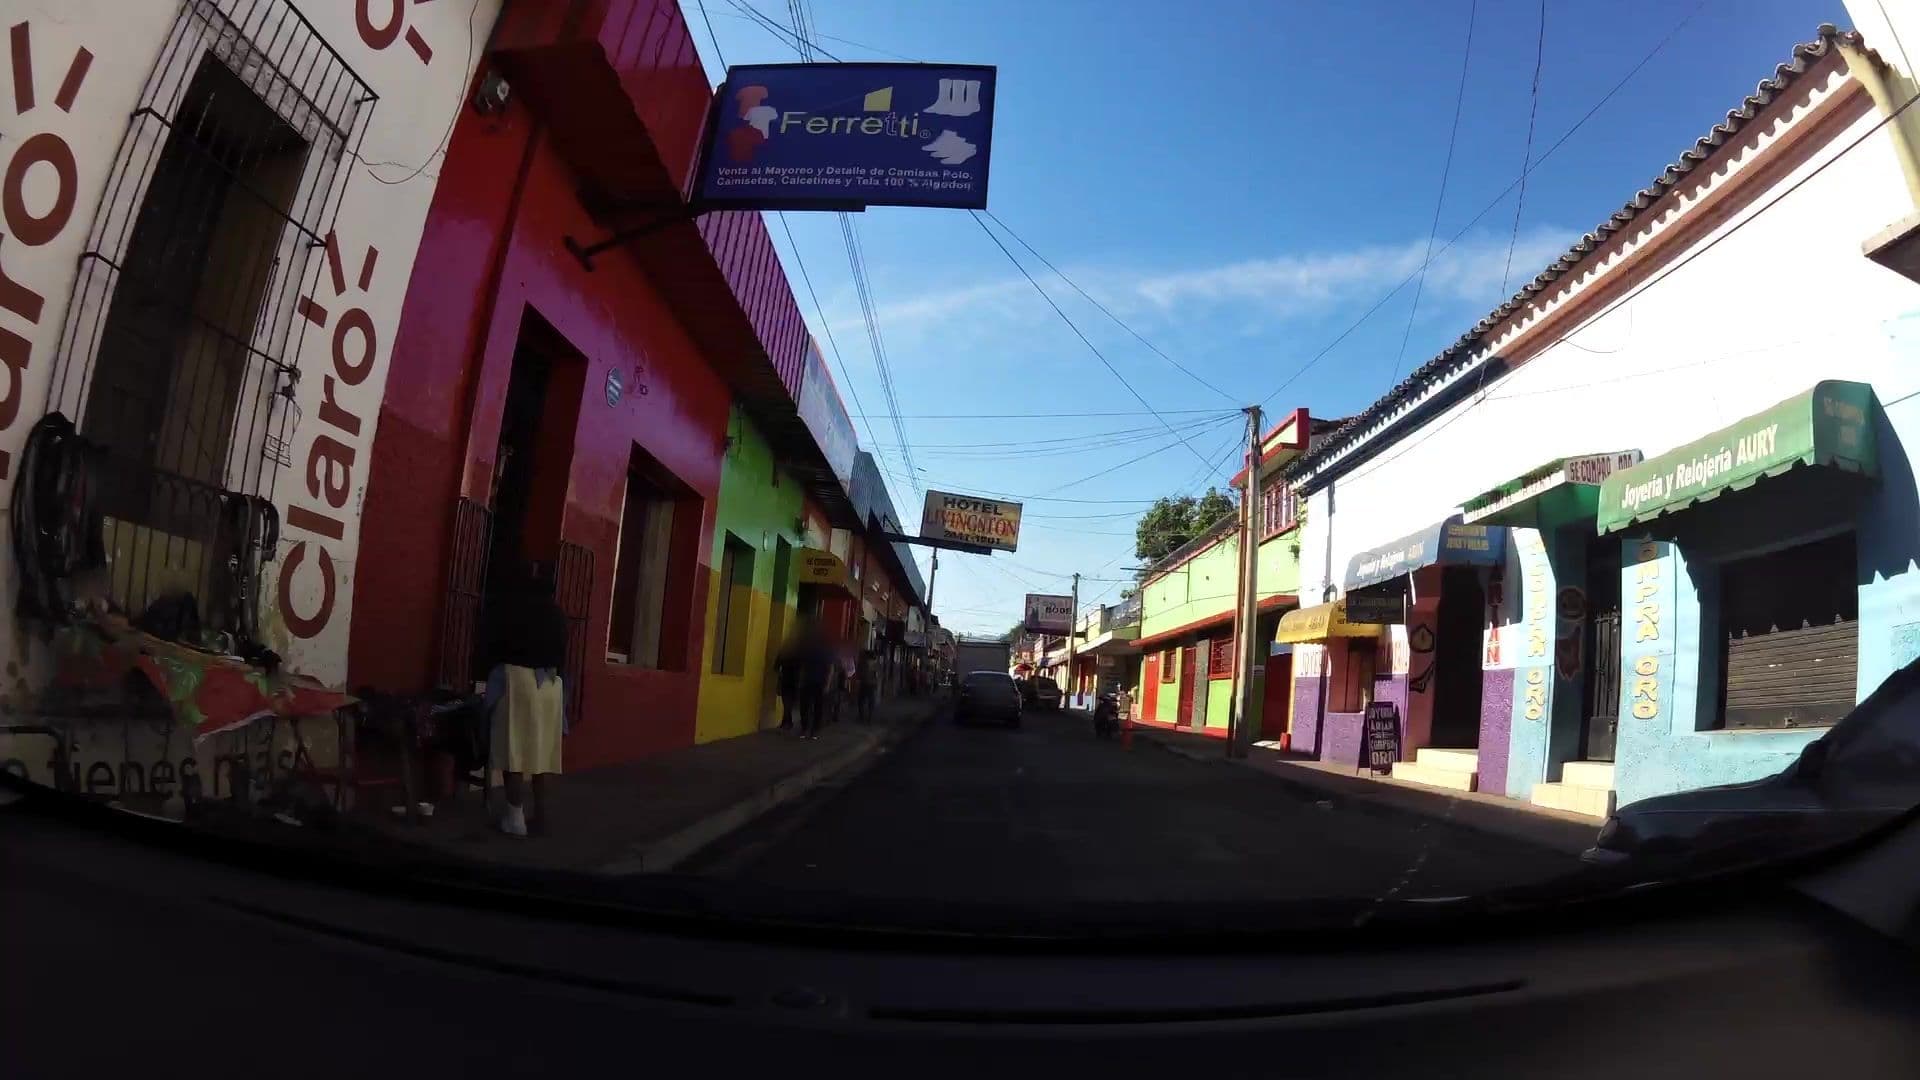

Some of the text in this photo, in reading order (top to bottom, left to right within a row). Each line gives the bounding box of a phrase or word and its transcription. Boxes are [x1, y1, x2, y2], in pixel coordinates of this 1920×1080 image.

[780, 111, 919, 138] Ferretti
[717, 177, 777, 186] Camisetas,
[781, 176, 841, 185] Calcetines
[845, 178, 853, 187] y
[856, 177, 879, 186] Tela
[884, 178, 904, 187] 100
[718, 167, 748, 176] Venta
[751, 167, 761, 176] al
[765, 166, 814, 177] Mayoreo
[816, 168, 824, 177] y
[826, 166, 866, 176] Detalle
[870, 167, 885, 176] de
[888, 167, 938, 178] Camisas
[1664, 472, 1674, 499] y
[1736, 423, 1779, 466] AURY
[943, 497, 1003, 516] HOTEL
[1632, 655, 1660, 720] ORO
